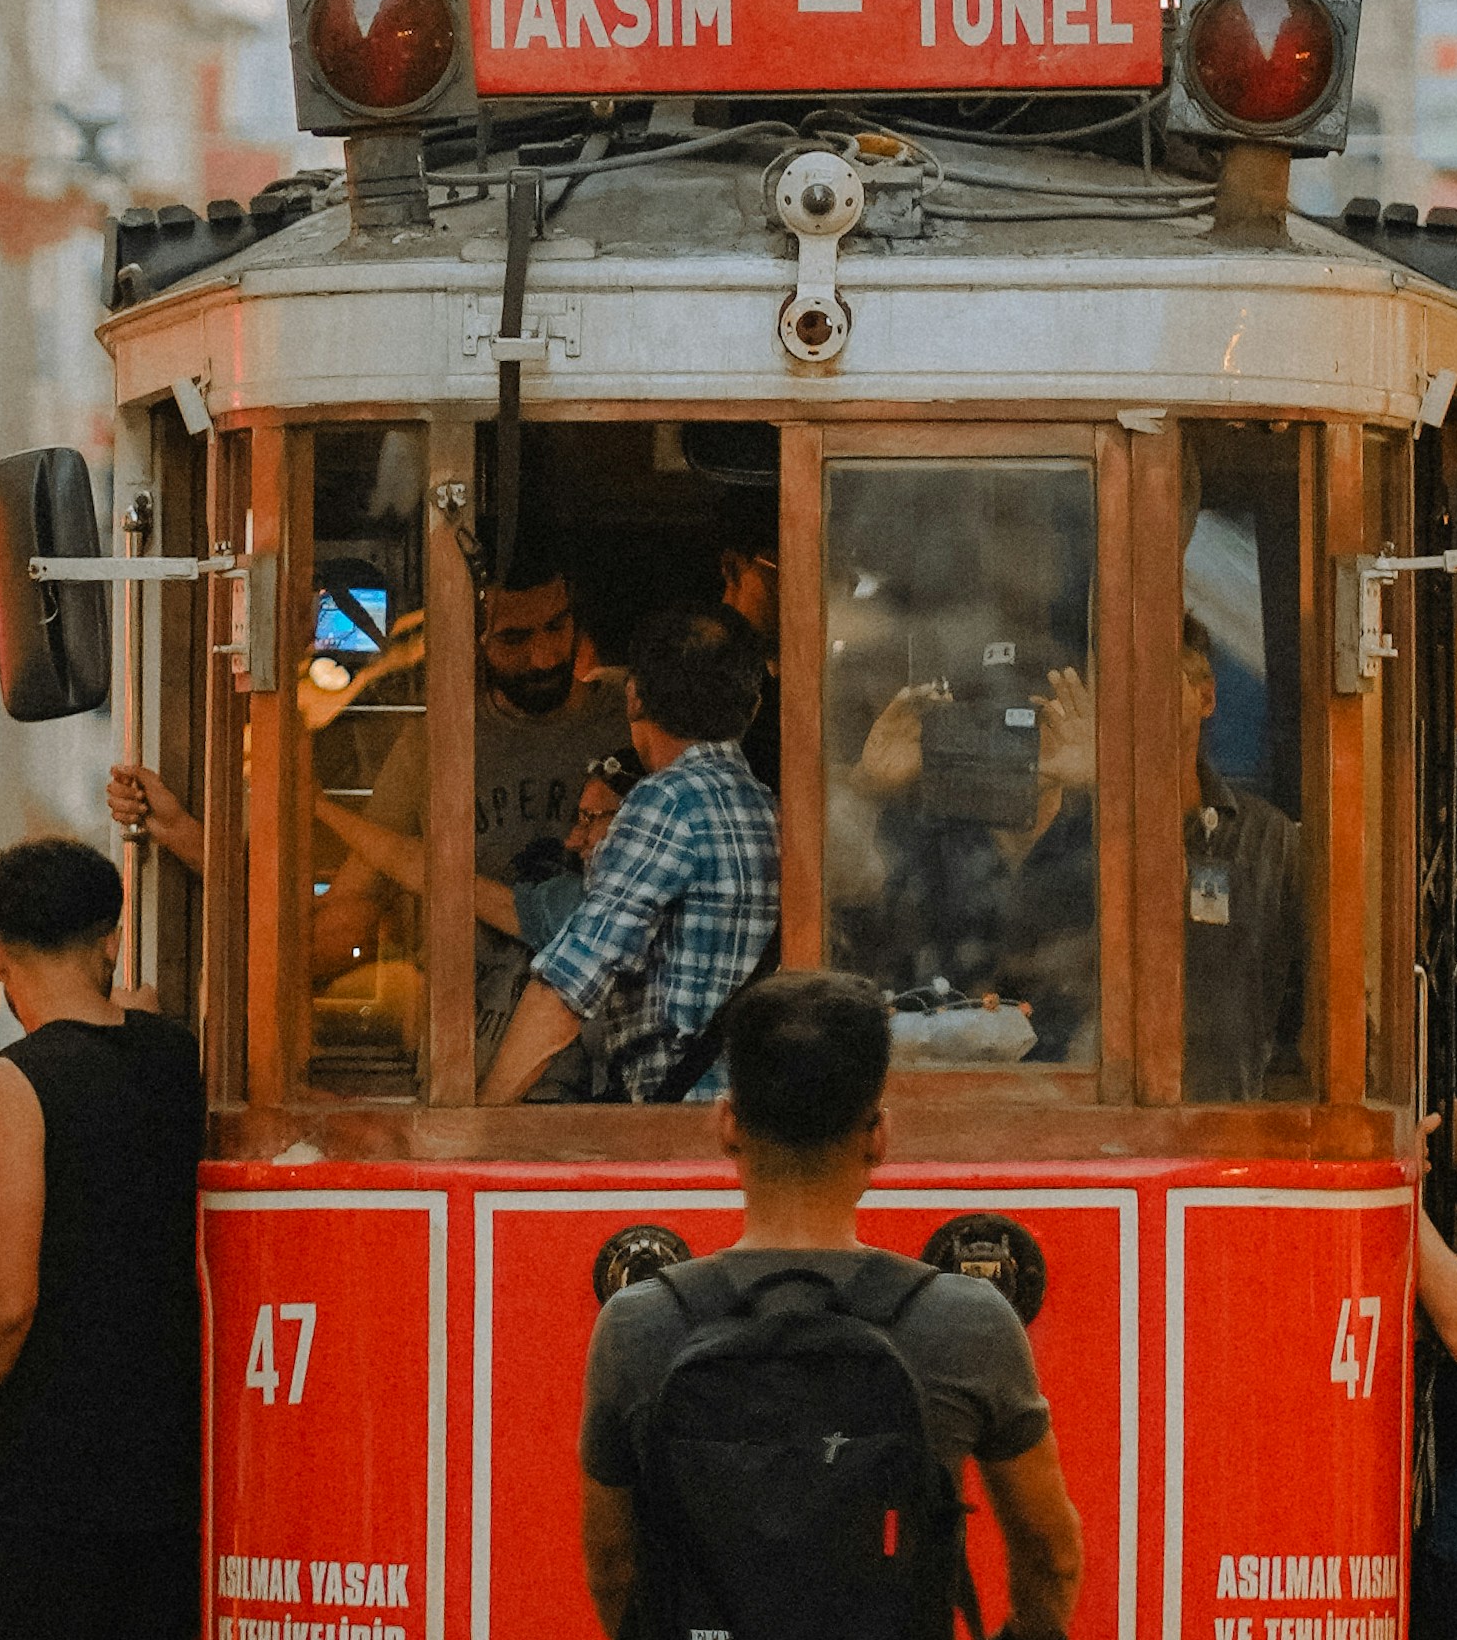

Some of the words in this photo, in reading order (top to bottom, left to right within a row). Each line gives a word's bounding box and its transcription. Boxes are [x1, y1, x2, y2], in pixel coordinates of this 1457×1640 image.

[245, 1302, 317, 1406] 47
[1330, 1295, 1381, 1400] 47
[218, 1554, 301, 1604] ASILMAK
[309, 1560, 410, 1608] YASAK
[1216, 1554, 1342, 1600] ASILMAK
